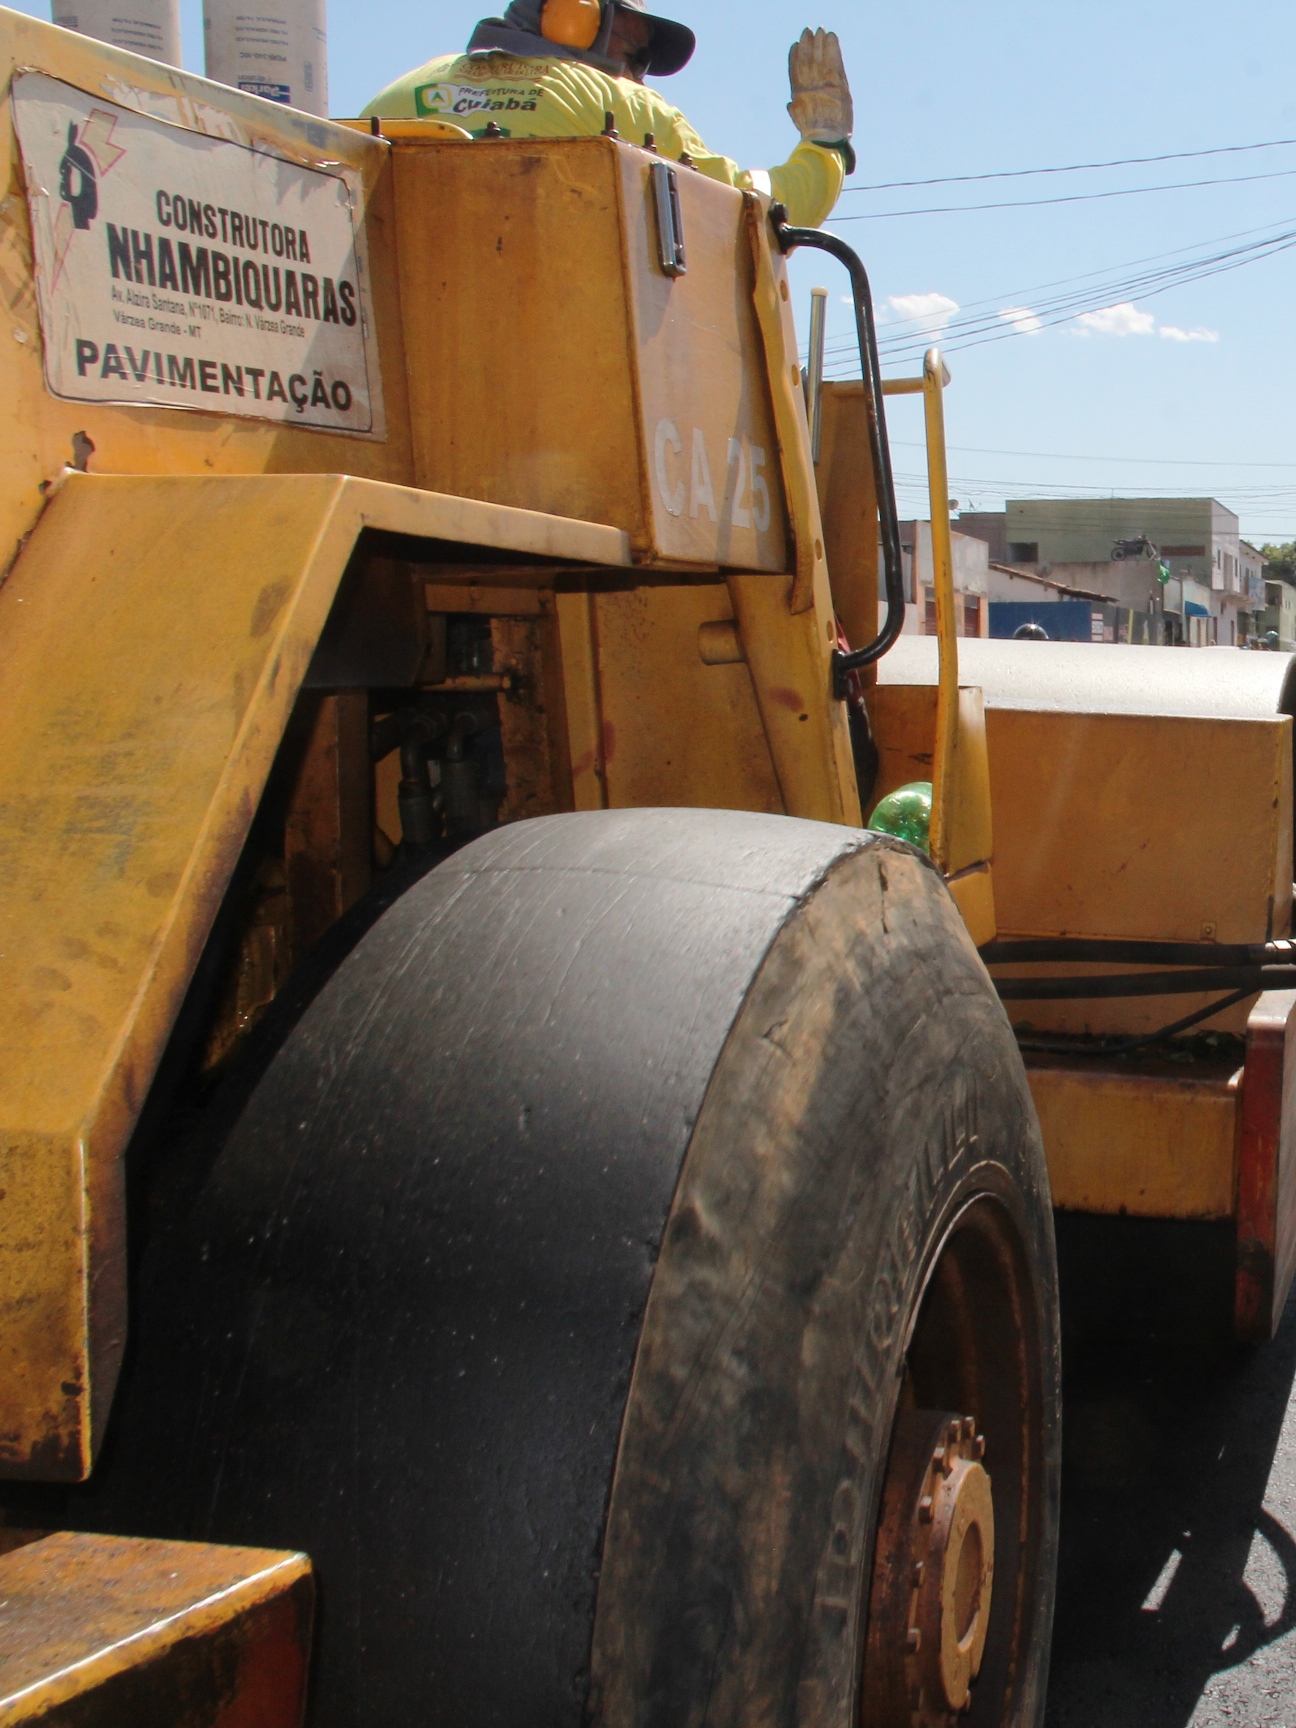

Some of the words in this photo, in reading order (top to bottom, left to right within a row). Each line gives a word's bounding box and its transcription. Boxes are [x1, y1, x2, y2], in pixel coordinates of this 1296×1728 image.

[459, 87, 525, 97] PREFEITURA
[528, 88, 544, 97] DE
[156, 189, 311, 264] CONSTRUTORA
[106, 222, 357, 327] NHAMBIQUARAS
[148, 316, 181, 336] Grande
[189, 324, 202, 339] MT
[280, 319, 305, 338] Grande
[75, 337, 352, 413] PAVIMENTAÇÃO
[654, 418, 717, 523] CA
[727, 436, 770, 532] 25
